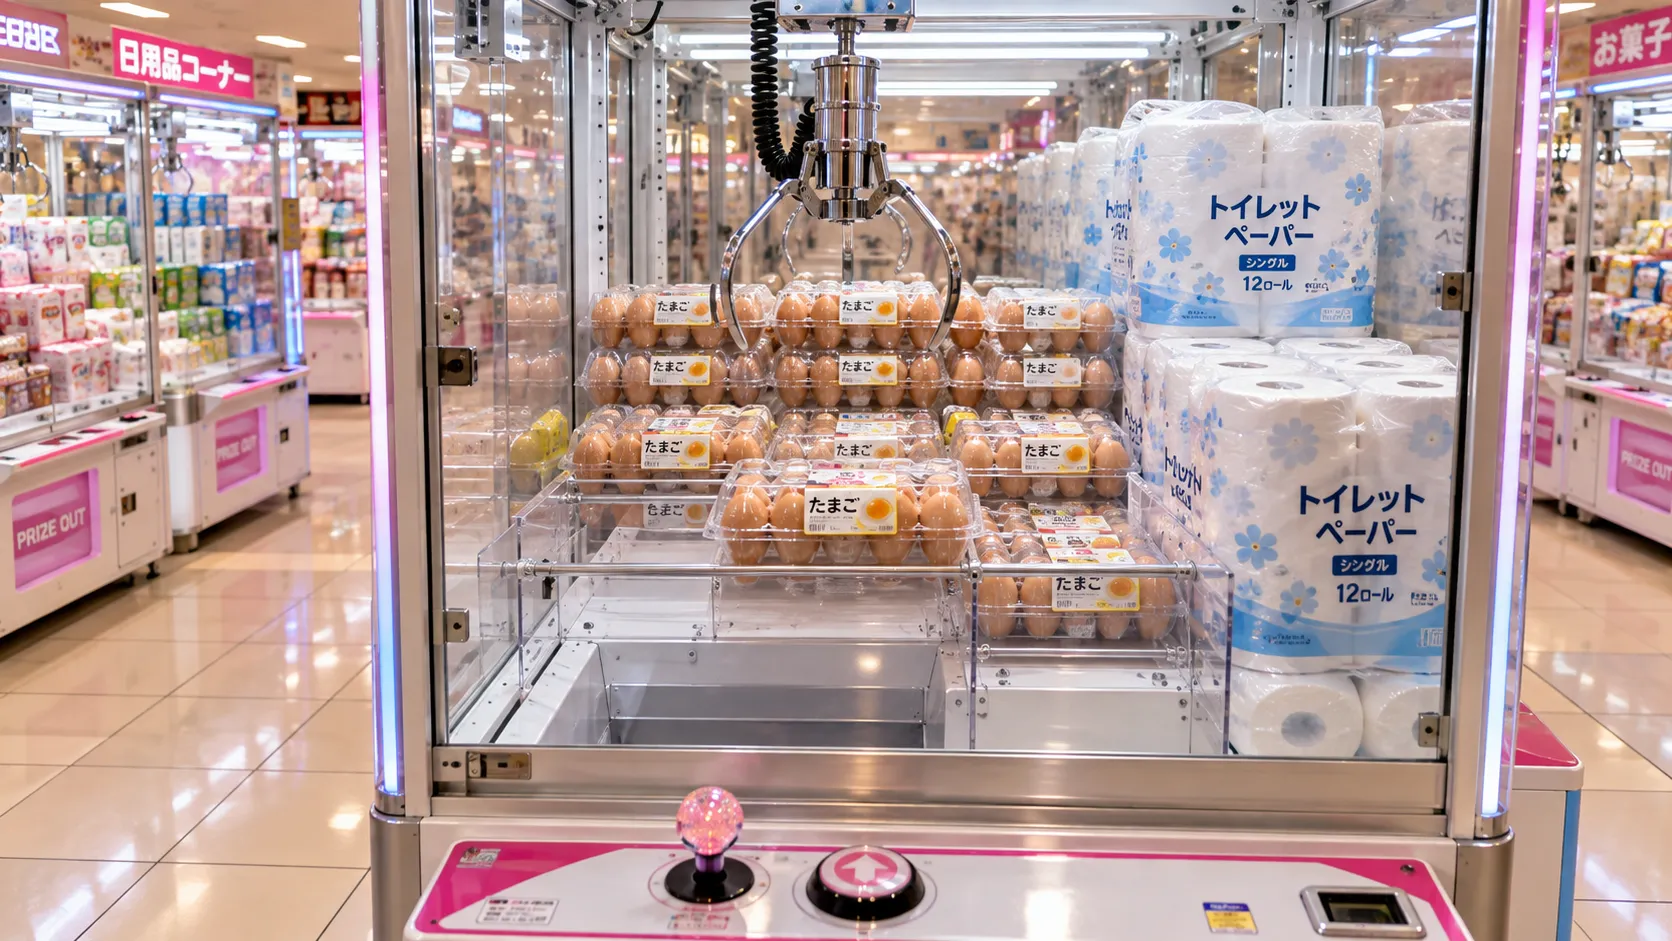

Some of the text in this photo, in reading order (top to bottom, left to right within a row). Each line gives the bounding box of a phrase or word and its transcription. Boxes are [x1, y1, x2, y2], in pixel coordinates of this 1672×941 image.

[1594, 17, 1672, 67] お菓子
[120, 38, 250, 89] 日用品コーナー
[1211, 194, 1320, 219] トイレット
[1224, 224, 1314, 246] ペーパー
[1246, 257, 1289, 269] シングル
[1243, 275, 1293, 291] 12ロール
[658, 301, 690, 312] たまご
[842, 300, 874, 311] たまご
[1027, 305, 1057, 316] たまご
[653, 360, 687, 372] たまご
[842, 360, 874, 372] たまご
[1026, 362, 1057, 373] たまご
[645, 440, 683, 453] たまご
[836, 443, 872, 456] たまご
[1025, 444, 1061, 457] たまご
[809, 497, 860, 513] たまご
[1300, 484, 1425, 515] トイレット
[17, 507, 86, 550] PRIZE OUT
[1316, 518, 1417, 545] ペーパー
[1340, 558, 1389, 573] シングル
[1056, 576, 1103, 591] たまご
[1336, 583, 1394, 603] 12ロール
